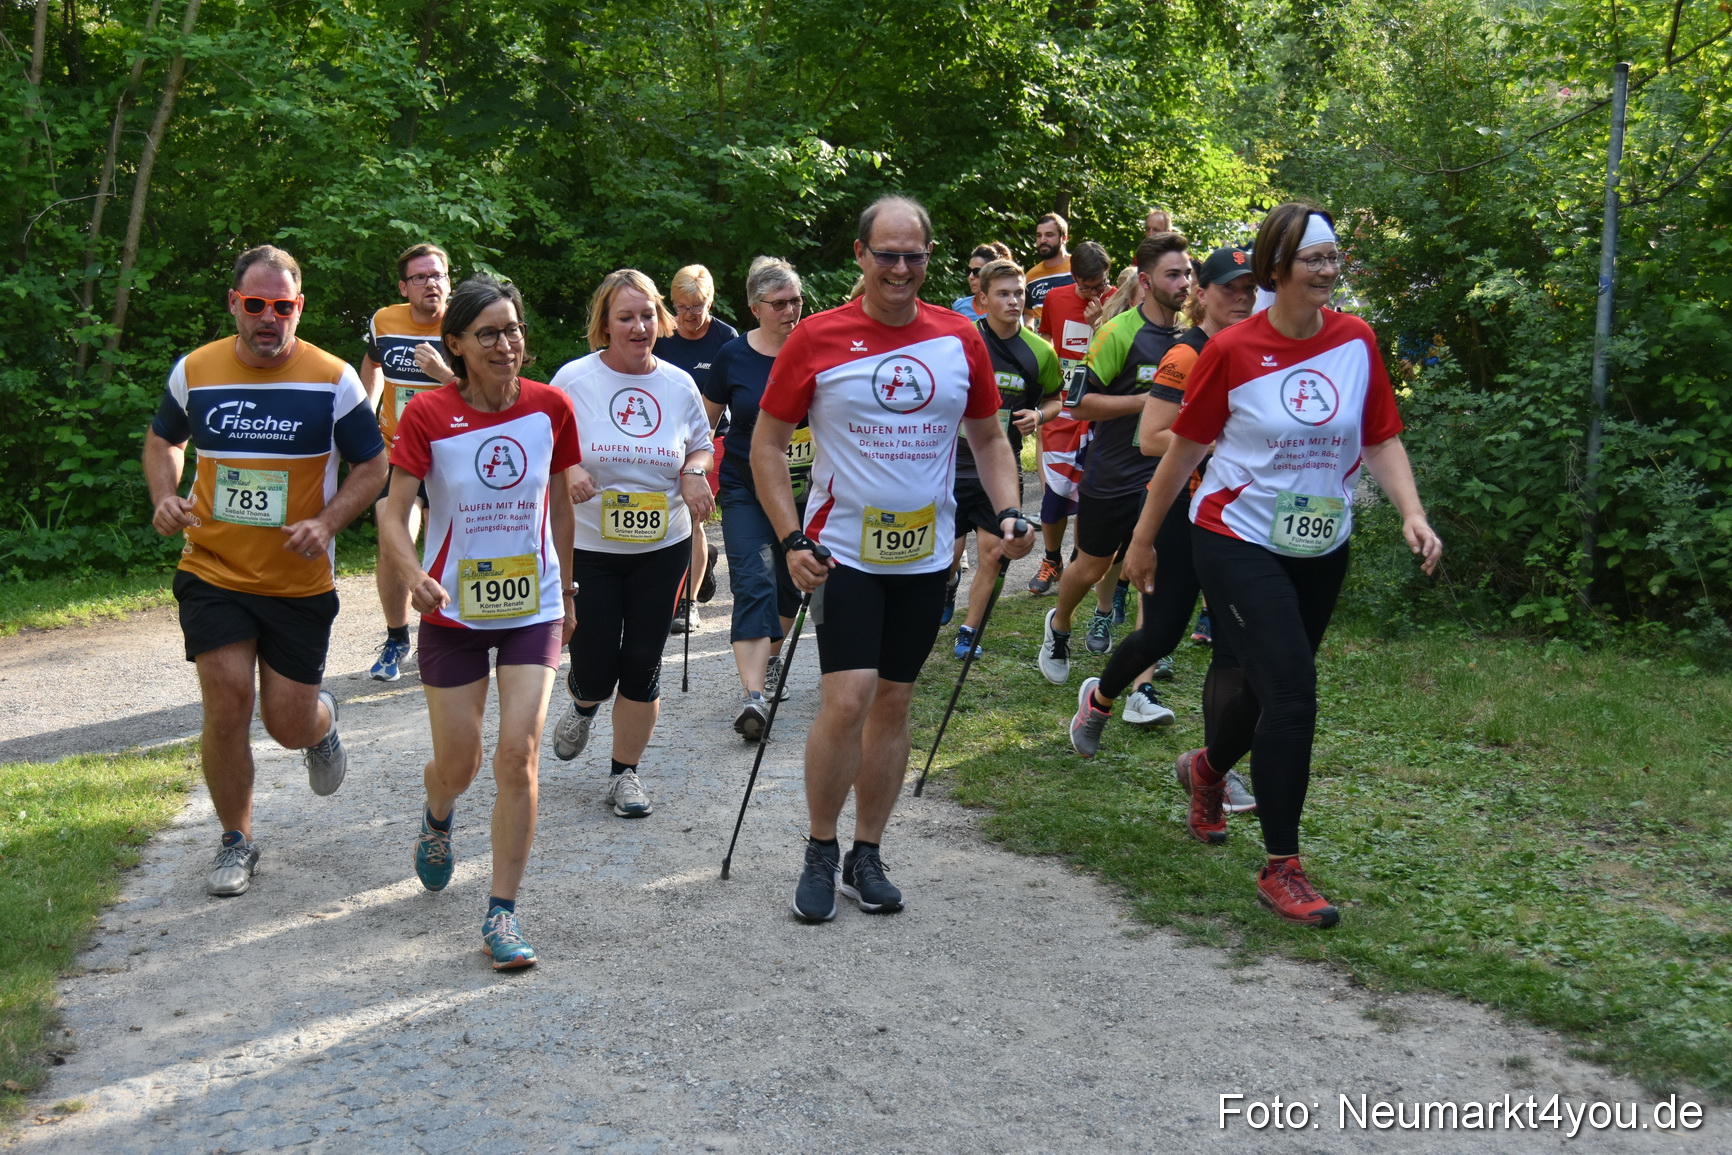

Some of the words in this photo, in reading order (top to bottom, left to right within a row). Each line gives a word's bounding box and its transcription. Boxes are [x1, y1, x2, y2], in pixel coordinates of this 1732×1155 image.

[221, 414, 303, 432] Fischer
[848, 423, 893, 434] LAUFEN
[898, 425, 918, 434] MIT
[922, 423, 947, 434] HERZ
[228, 432, 295, 441] AUTOMOBILE
[859, 439, 871, 447] Dr.
[915, 439, 938, 447] Röschl
[1266, 438, 1305, 449] LAUFEN
[1308, 437, 1328, 446] MIT
[591, 442, 630, 453] LAUFEN
[635, 446, 653, 455] MIT
[657, 447, 680, 459] HERZ
[860, 450, 937, 461] Leistungsdiagnostik
[1286, 452, 1305, 460] Heck
[1321, 450, 1340, 459] Rösc
[612, 456, 631, 464] Heck
[650, 459, 673, 468] Röschl
[226, 487, 269, 511] 783
[225, 507, 246, 515] Siebald
[458, 502, 493, 513] LAUFEN
[496, 501, 514, 510] MIT
[517, 500, 538, 510] HERZ
[477, 514, 492, 522] Heck
[610, 510, 661, 529] 1898
[465, 524, 530, 534] Leistungsdiagnostik
[1283, 514, 1335, 539] 1896
[872, 525, 929, 550] 1907
[470, 576, 530, 603] 1900
